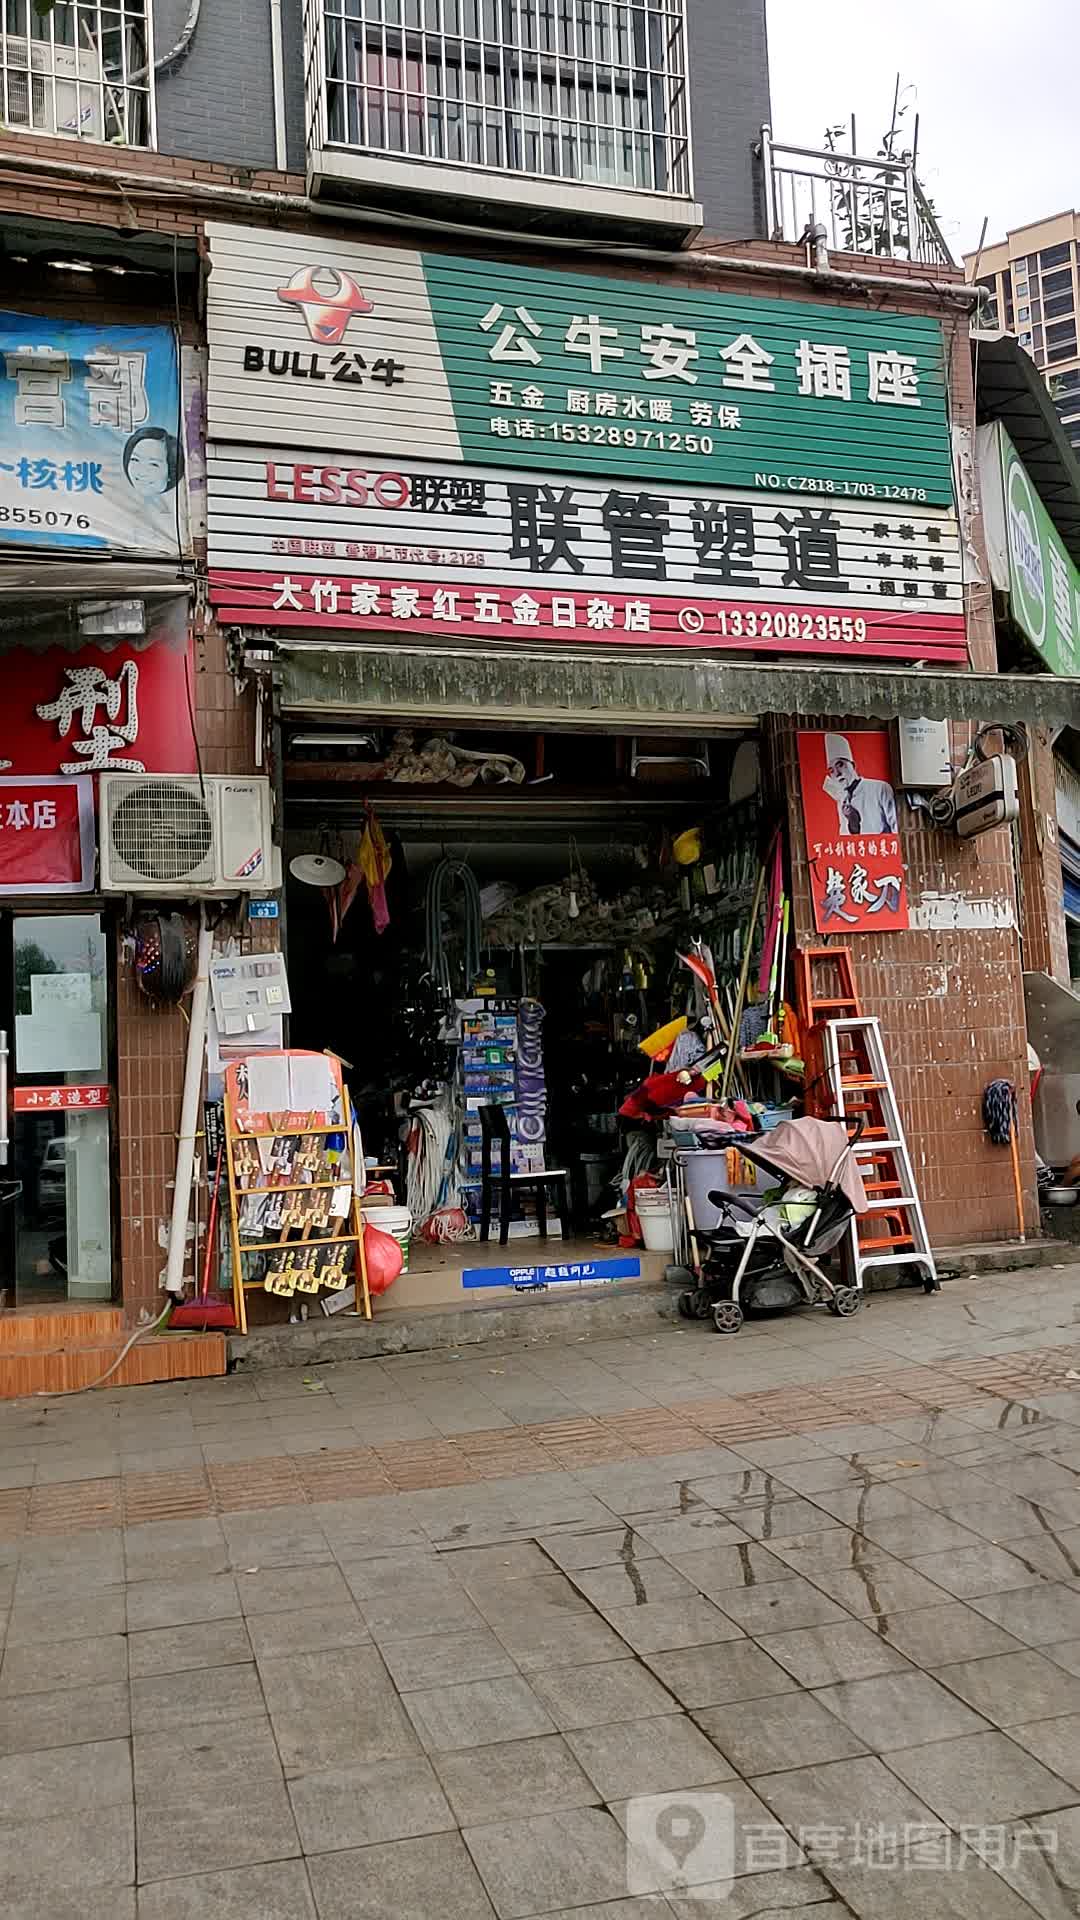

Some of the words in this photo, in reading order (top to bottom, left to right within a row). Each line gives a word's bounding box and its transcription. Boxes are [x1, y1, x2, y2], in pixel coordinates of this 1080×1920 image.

[478, 301, 922, 408] 公牛安全插座
[489, 381, 545, 411] 五金
[566, 390, 674, 425] 厨房水暖
[689, 401, 743, 431] 劳保
[272, 576, 651, 633] 大竹家家红五金日杂店
[717, 610, 867, 643] 13320823559
[0, 659, 146, 774] 型
[0, 799, 57, 831] 本店
